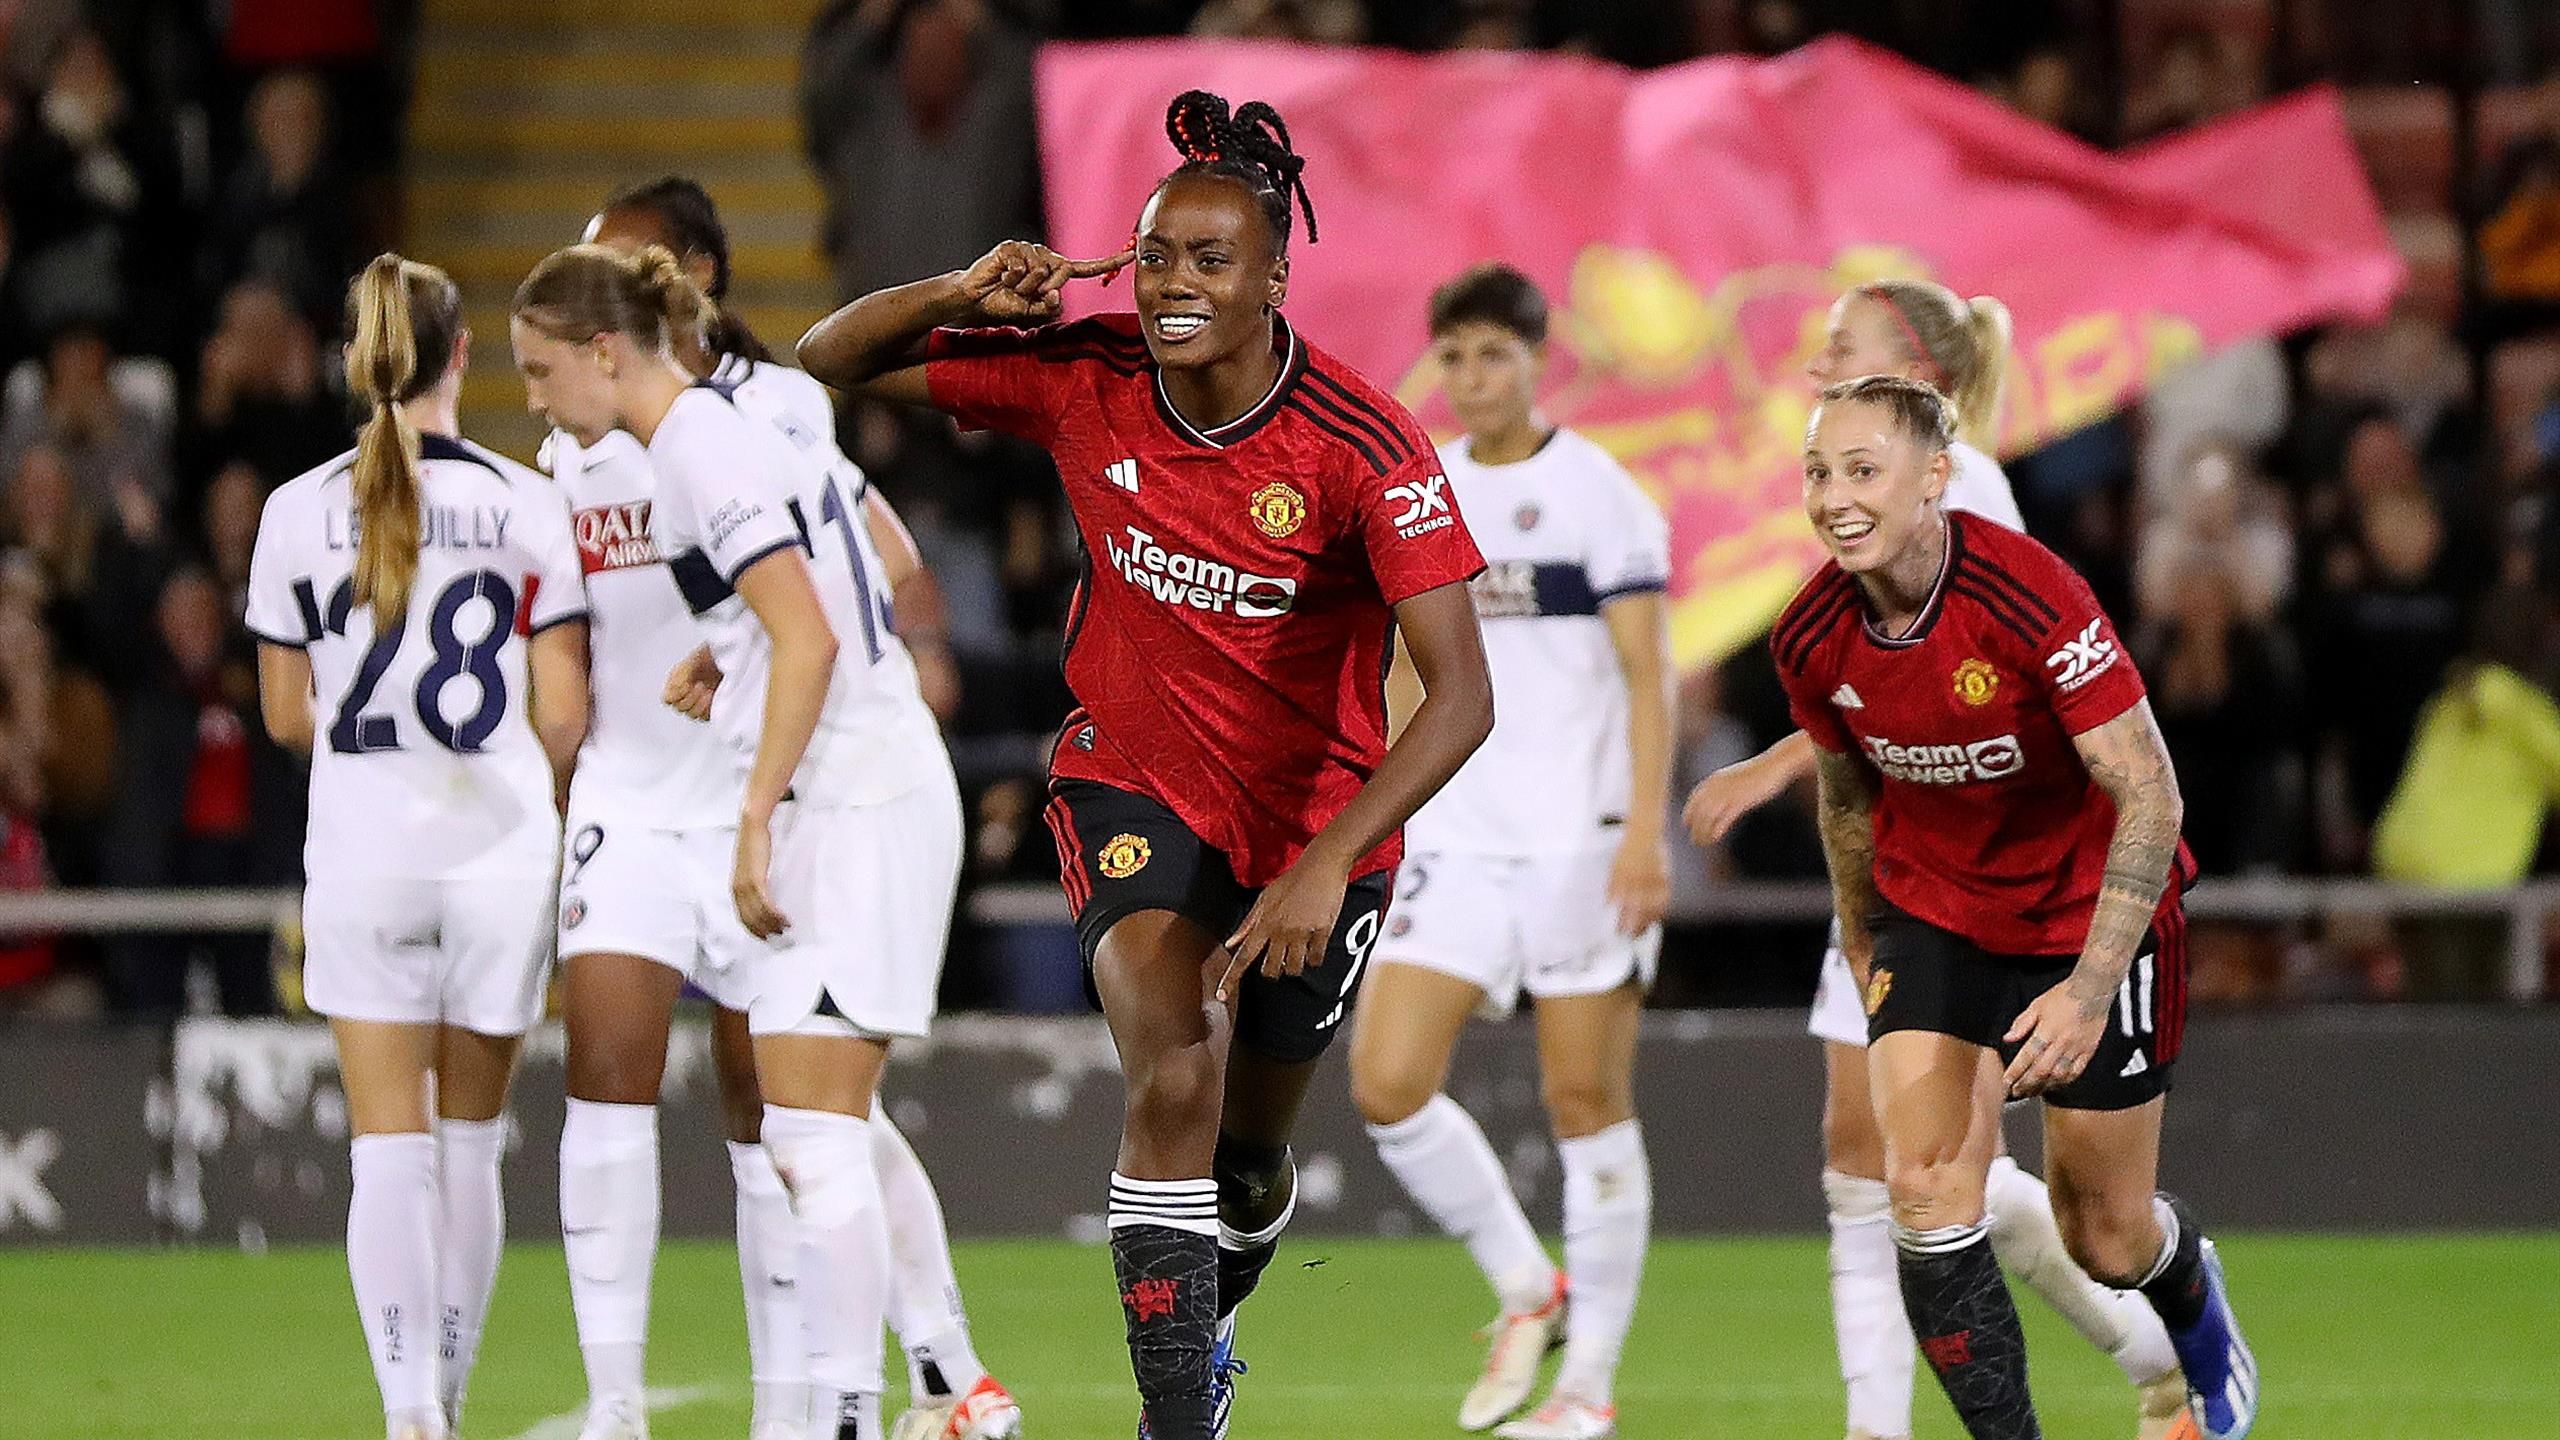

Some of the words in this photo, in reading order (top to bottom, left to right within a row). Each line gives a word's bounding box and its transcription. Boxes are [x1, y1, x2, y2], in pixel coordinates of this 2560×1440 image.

[576, 502, 651, 555] QAT
[1126, 525, 1234, 592] Team
[1105, 533, 1231, 612] Viewer
[325, 568, 516, 753] 28
[1864, 735, 1967, 766] Team
[1868, 752, 1971, 783] ewer
[573, 822, 605, 890] 9
[1338, 909, 1379, 998] 9
[2119, 953, 2155, 1037] 11
